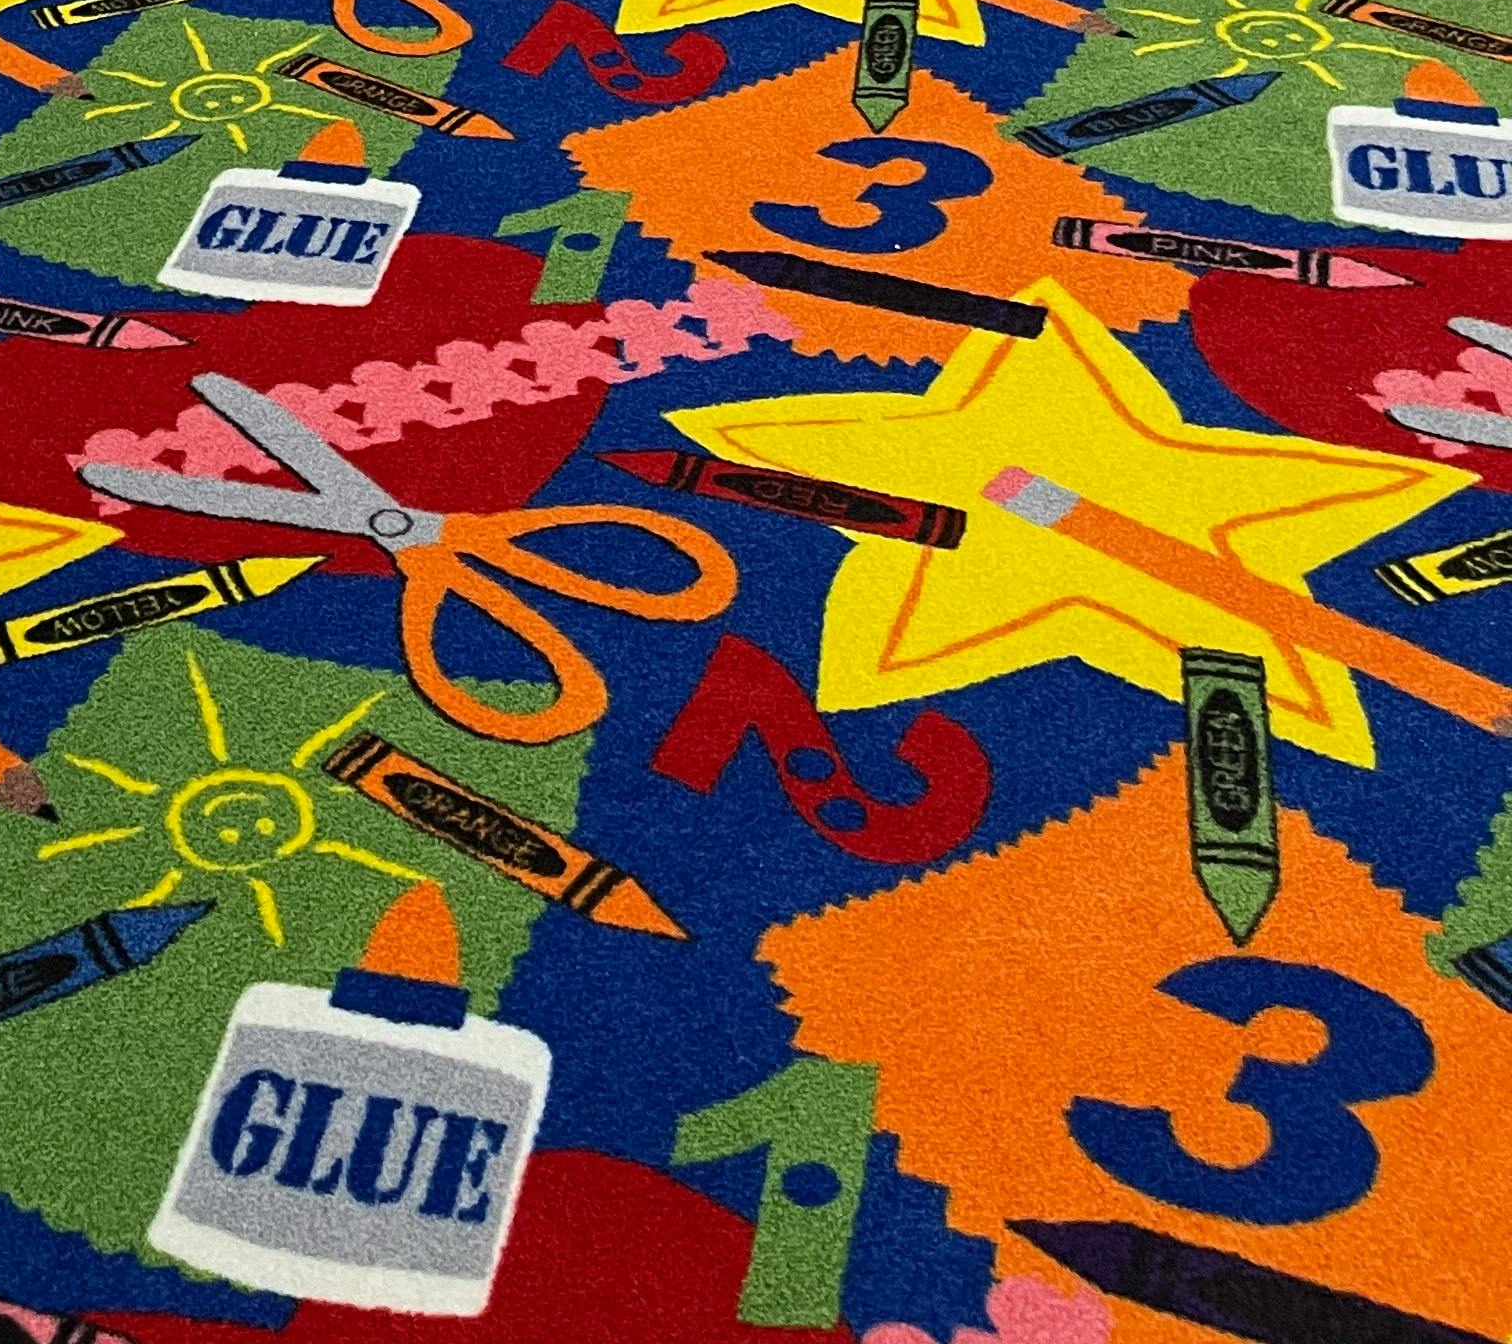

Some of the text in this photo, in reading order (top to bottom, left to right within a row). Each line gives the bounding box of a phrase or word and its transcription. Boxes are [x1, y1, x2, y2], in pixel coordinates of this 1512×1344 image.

[331, 74, 424, 112] ORANGE
[195, 203, 389, 266] GLUE
[495, 189, 633, 304] 1
[750, 137, 995, 253] 3
[1151, 237, 1251, 266] PINK
[54, 590, 182, 637] YELLOW
[1206, 709, 1251, 812] GREEN
[404, 779, 546, 869] ORANGE
[1065, 955, 1436, 1225] 3
[209, 1068, 508, 1224] GLUE
[671, 1057, 880, 1331] 1
